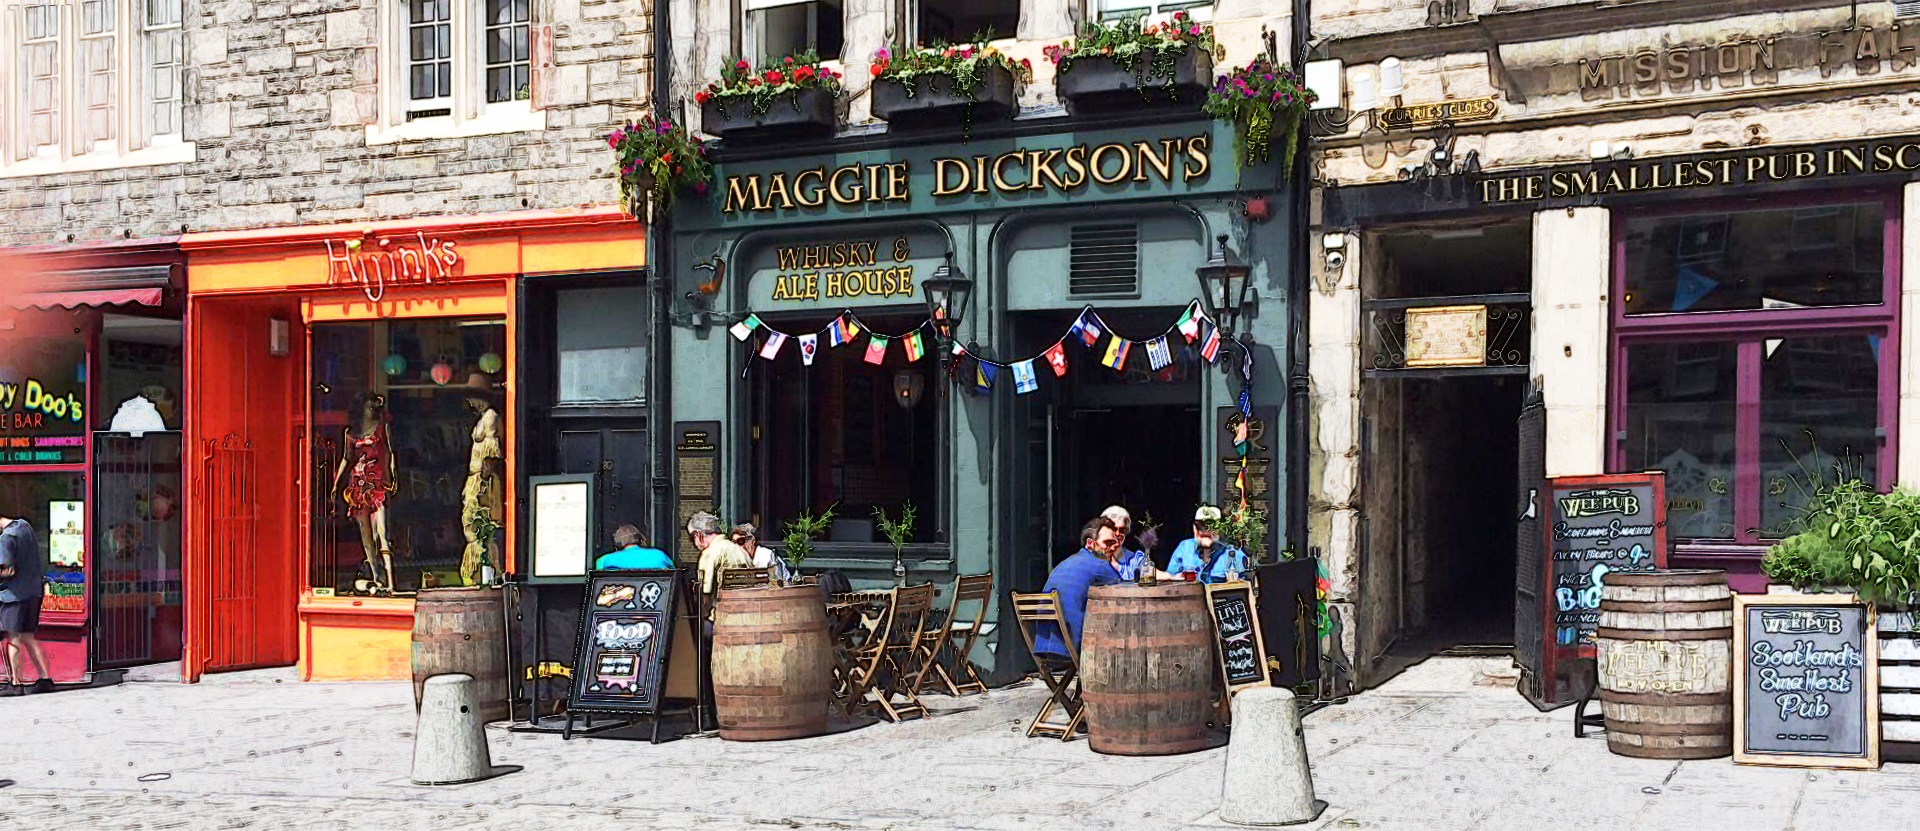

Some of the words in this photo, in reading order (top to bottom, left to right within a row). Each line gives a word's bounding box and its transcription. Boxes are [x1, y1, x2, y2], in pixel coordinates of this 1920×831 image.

[1578, 38, 1775, 88] MISSION
[1449, 101, 1487, 114] CLOSE
[723, 161, 908, 213] MAGGIE
[932, 134, 1209, 196] DICKSON'S
[1477, 175, 1544, 202] THE
[1551, 157, 1736, 197] SMALLEST
[1746, 151, 1816, 181] PUB
[1826, 147, 1864, 174] IN
[324, 231, 457, 301] Hijinks
[777, 240, 878, 270] WHISKY
[893, 237, 909, 262] &
[773, 272, 818, 300] ALE
[826, 267, 912, 298] HOUSE
[25, 380, 83, 421] Doo's
[15, 412, 42, 428] BAR
[1561, 498, 1600, 517] WEE
[1602, 496, 1639, 515] PUB
[1556, 586, 1602, 611] BIG
[1762, 618, 1803, 633] WEE
[1805, 618, 1842, 633] PUB
[1635, 641, 1668, 651] THE
[1651, 680, 1693, 692] OPEN
[1760, 668, 1851, 694] Smallest
[1776, 693, 1829, 720] Pub
